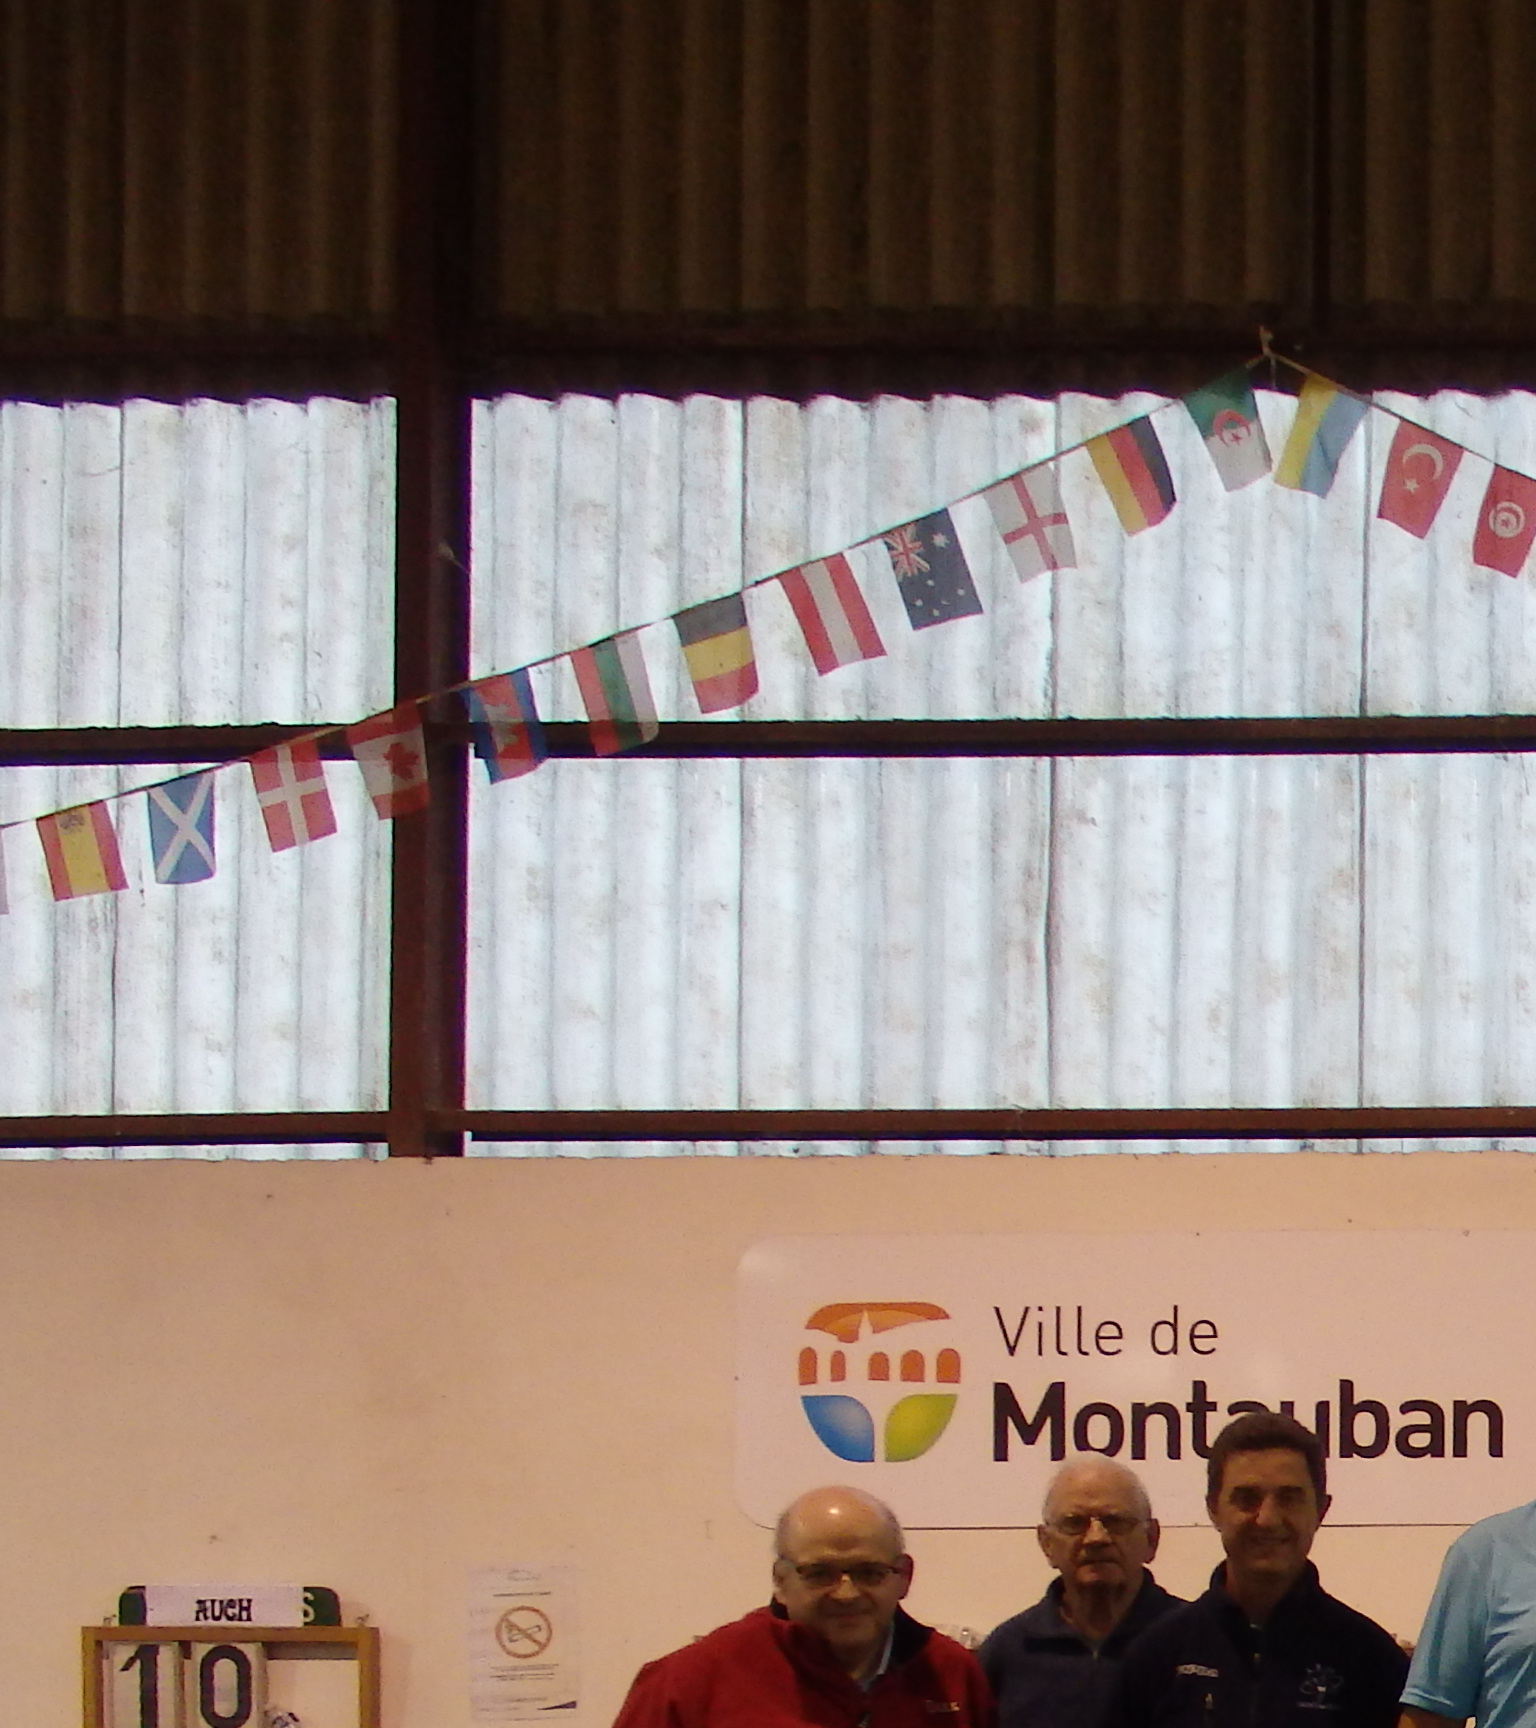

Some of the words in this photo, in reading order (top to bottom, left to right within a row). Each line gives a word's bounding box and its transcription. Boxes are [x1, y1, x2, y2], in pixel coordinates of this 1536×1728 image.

[993, 1304, 1125, 1357] Ville
[1149, 1304, 1220, 1356] de
[992, 1378, 1504, 1462] Montban
[195, 1598, 253, 1622] AUCH
